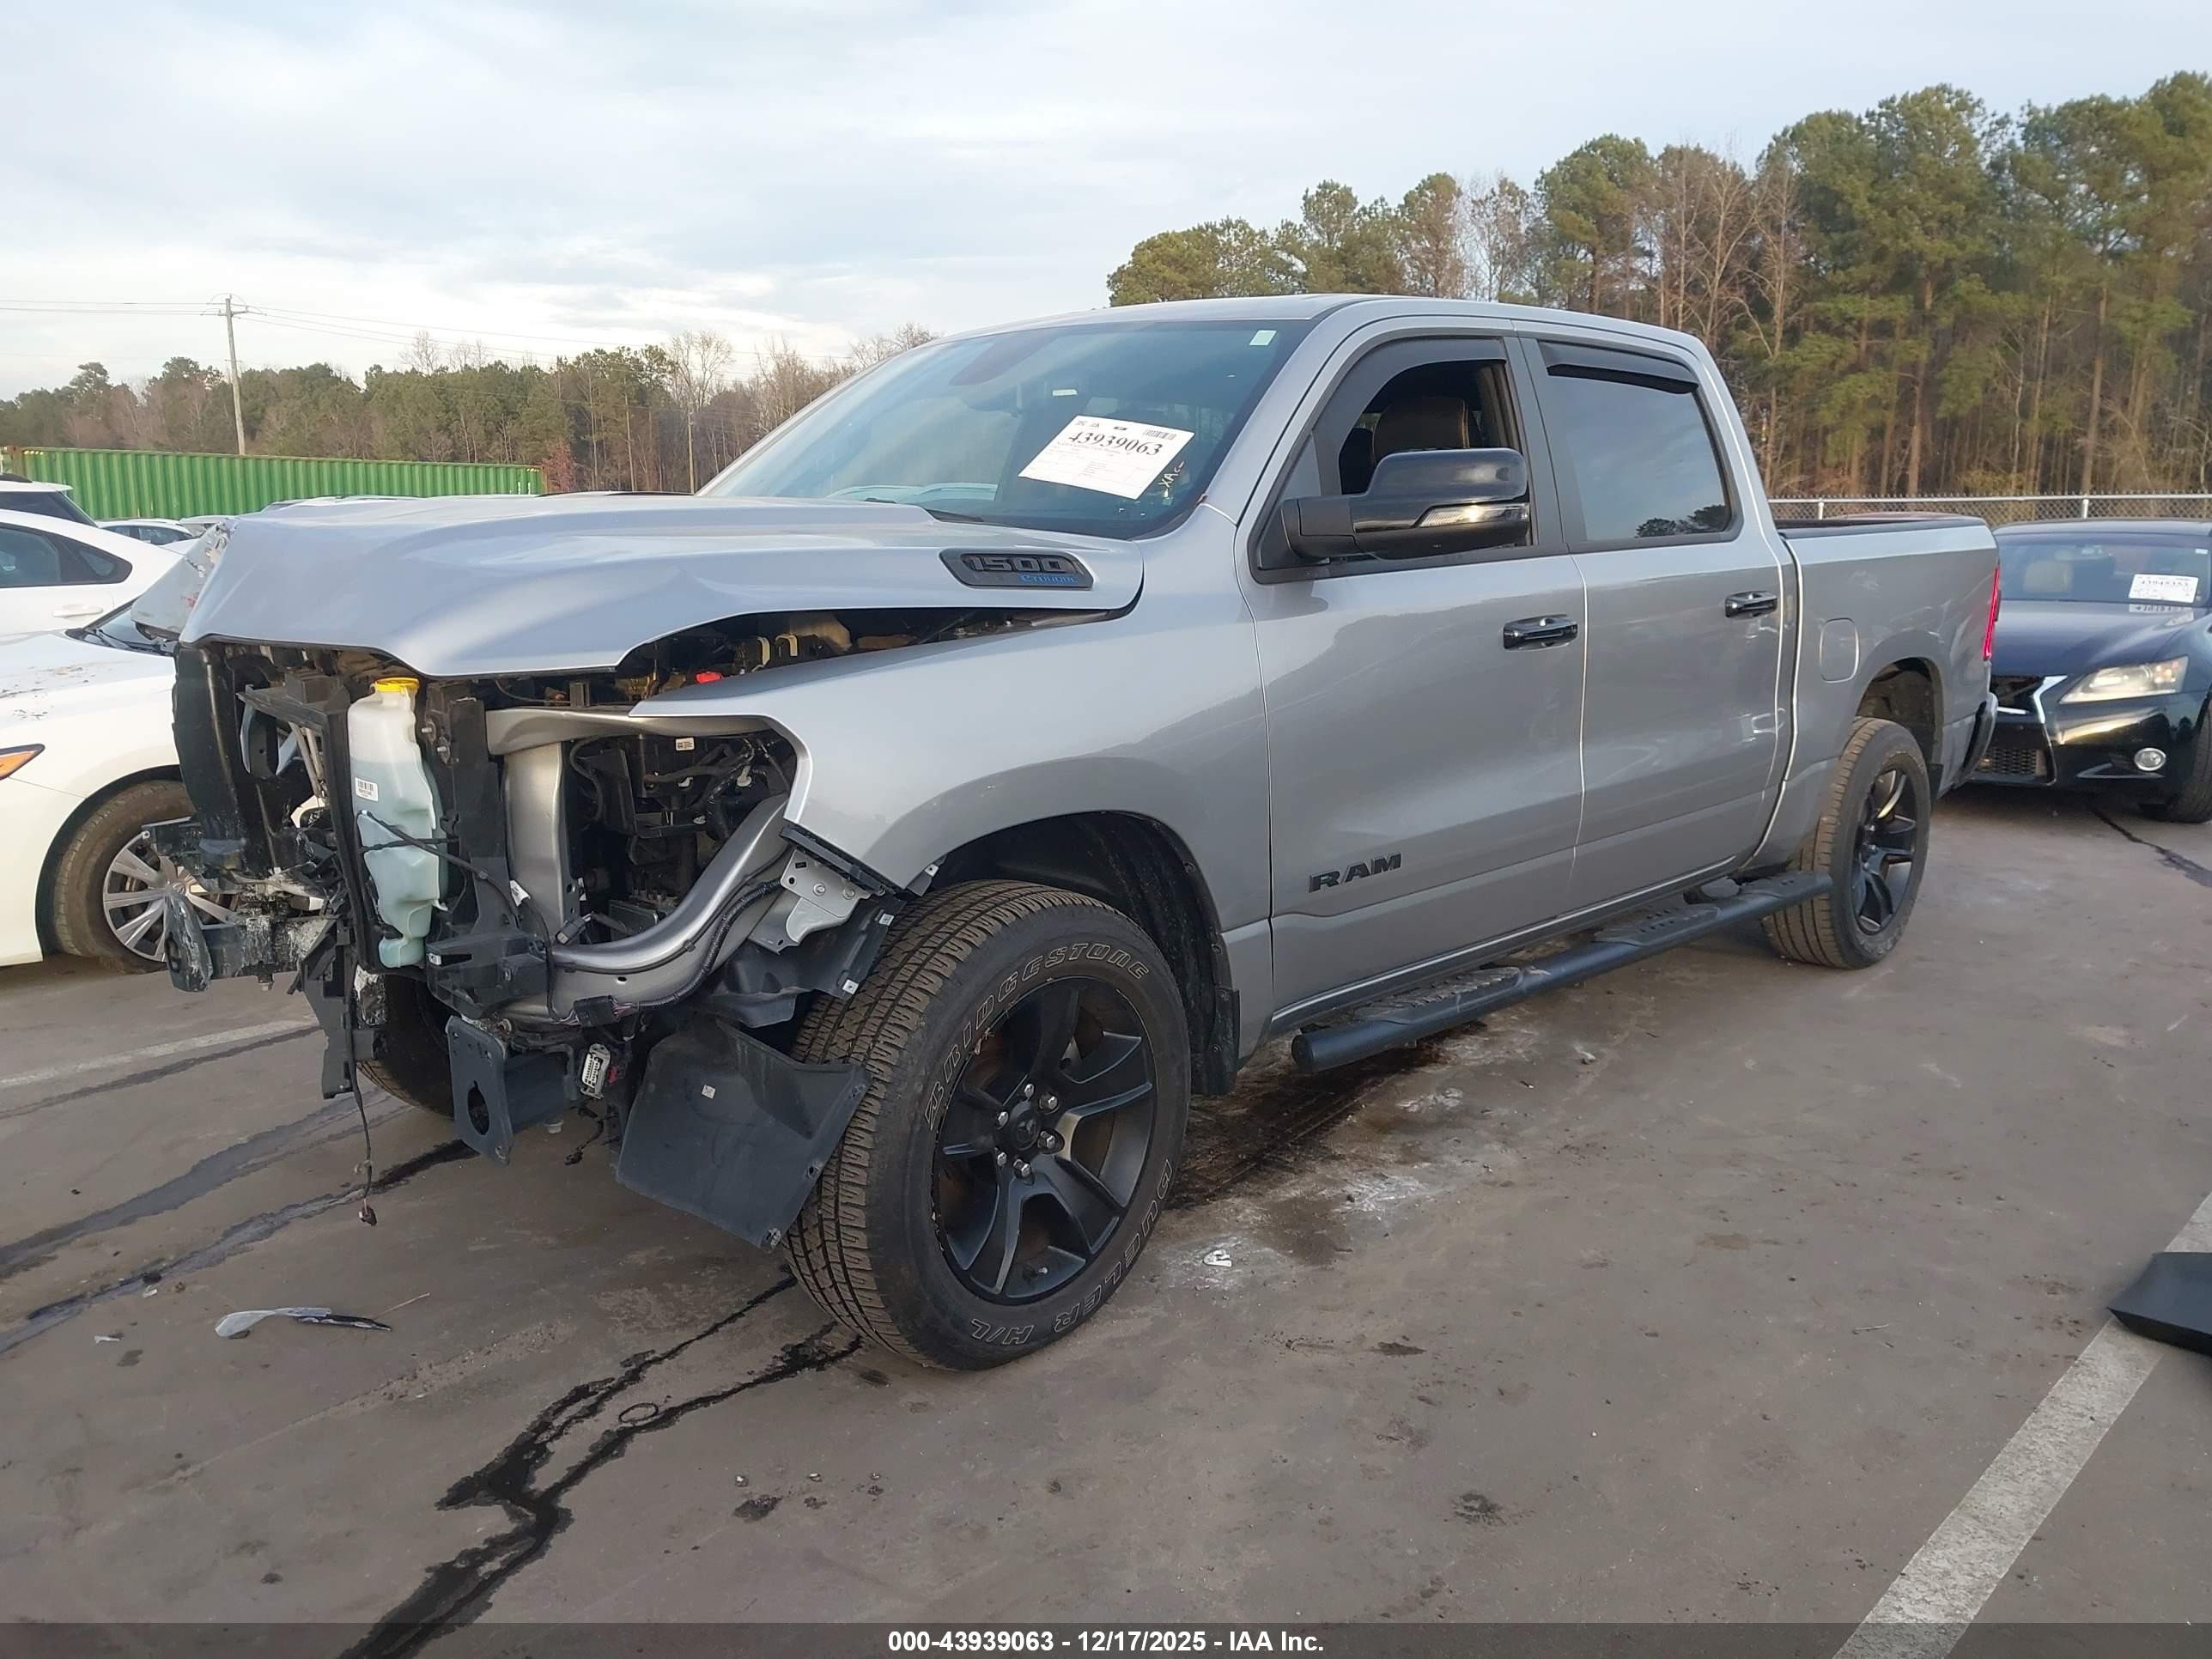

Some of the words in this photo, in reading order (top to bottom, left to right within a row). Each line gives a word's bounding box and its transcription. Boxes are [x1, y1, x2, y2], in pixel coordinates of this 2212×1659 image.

[1068, 431, 1164, 456] 43939063
[967, 555, 1066, 572] 1500
[1309, 852, 1401, 893] RAM
[923, 942, 1150, 1132] BRIDGESTONE
[1053, 1158, 1173, 1334] DUELER
[970, 1318, 1035, 1346] H/L
